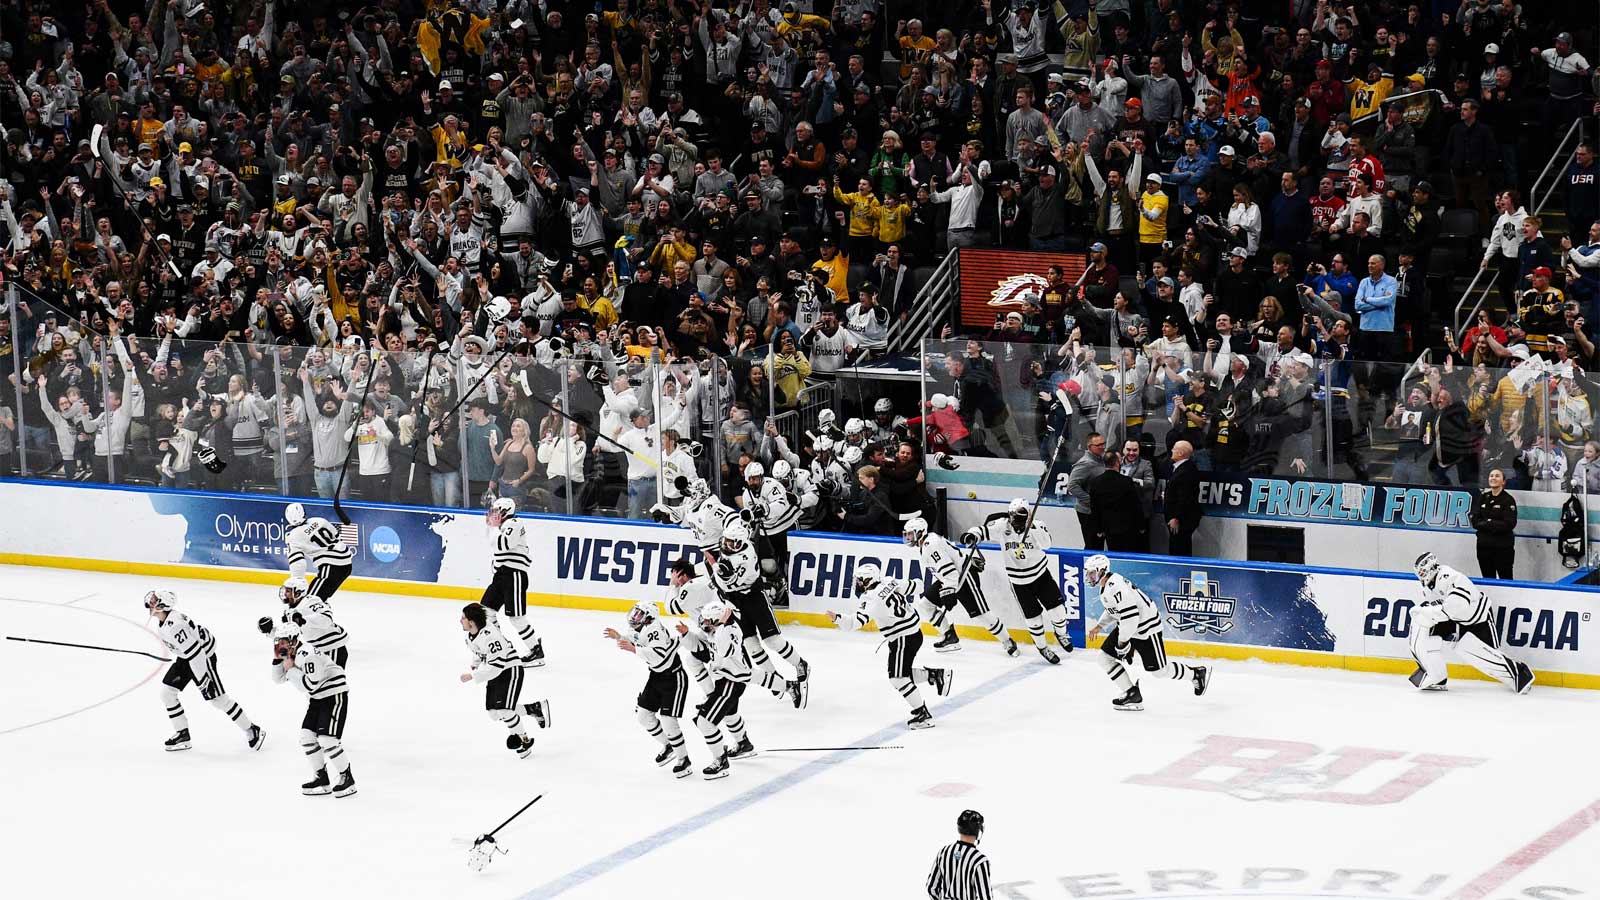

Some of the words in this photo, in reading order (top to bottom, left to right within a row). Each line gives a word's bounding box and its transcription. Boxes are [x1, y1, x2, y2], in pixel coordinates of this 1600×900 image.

[1375, 179, 1385, 189] 97
[1571, 174, 1594, 185] USA
[573, 228, 583, 238] 82
[803, 313, 812, 323] 16
[1248, 477, 1376, 522] FROZEN
[1382, 485, 1473, 529] FOUR
[714, 507, 726, 519] 31
[310, 527, 334, 547] 10
[222, 543, 259, 554] MADE
[371, 543, 401, 554] NCAA
[930, 551, 942, 564] 19
[680, 589, 688, 601] 8
[1063, 563, 1081, 620] NCAA
[1113, 590, 1123, 604] 17
[1170, 599, 1206, 612] FROZEN
[1206, 602, 1231, 614] FOUR
[174, 629, 188, 644] 27
[488, 640, 503, 654] 29
[303, 660, 316, 675] 18
